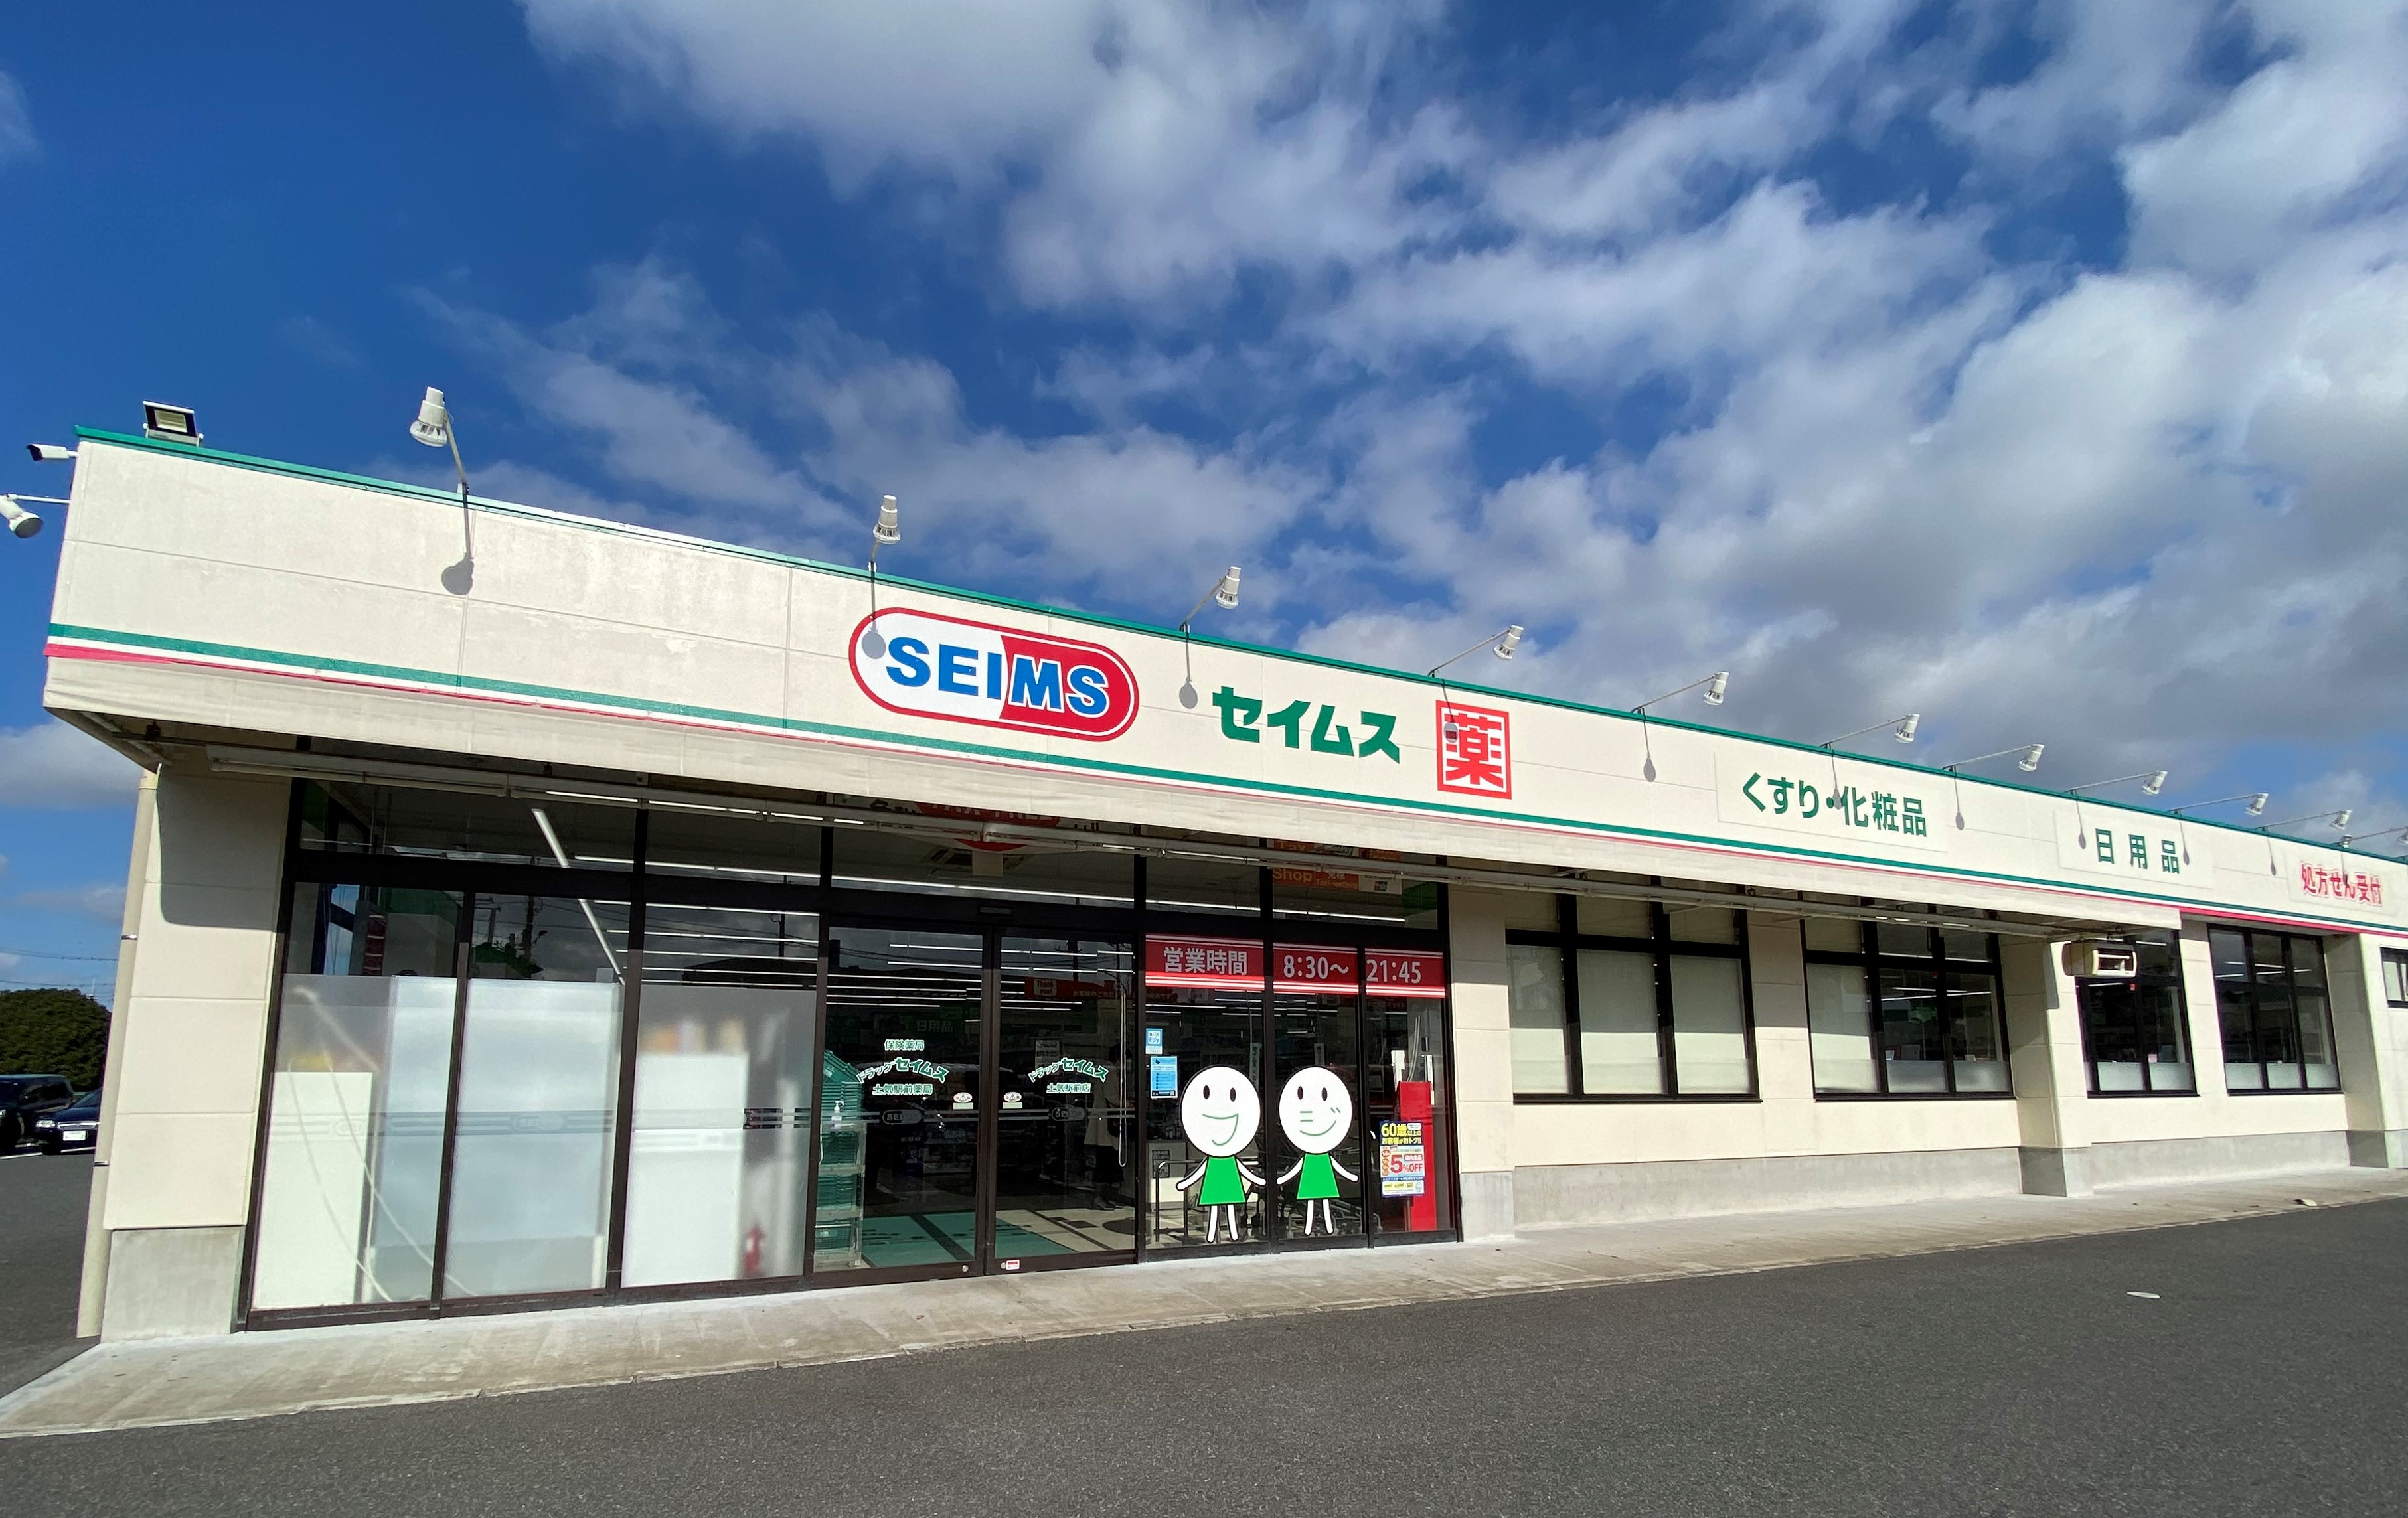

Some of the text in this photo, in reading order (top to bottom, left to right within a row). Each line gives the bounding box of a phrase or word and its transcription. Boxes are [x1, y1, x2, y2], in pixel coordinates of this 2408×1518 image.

[886, 636, 1111, 718] SEIMS
[1212, 685, 1400, 763] セイムス
[1444, 713, 1504, 789] 薬
[1742, 772, 1927, 837] くすり・化粧品
[2095, 828, 2180, 874] 日用品
[2300, 862, 2383, 907] 処方せん受付
[1163, 947, 1247, 976] 営業時間
[1366, 959, 1421, 984] 21:45
[884, 1039, 925, 1051] 保険薬局
[872, 1084, 933, 1095] 土気駅前薬局
[1046, 1083, 1091, 1094] 土気駅前店
